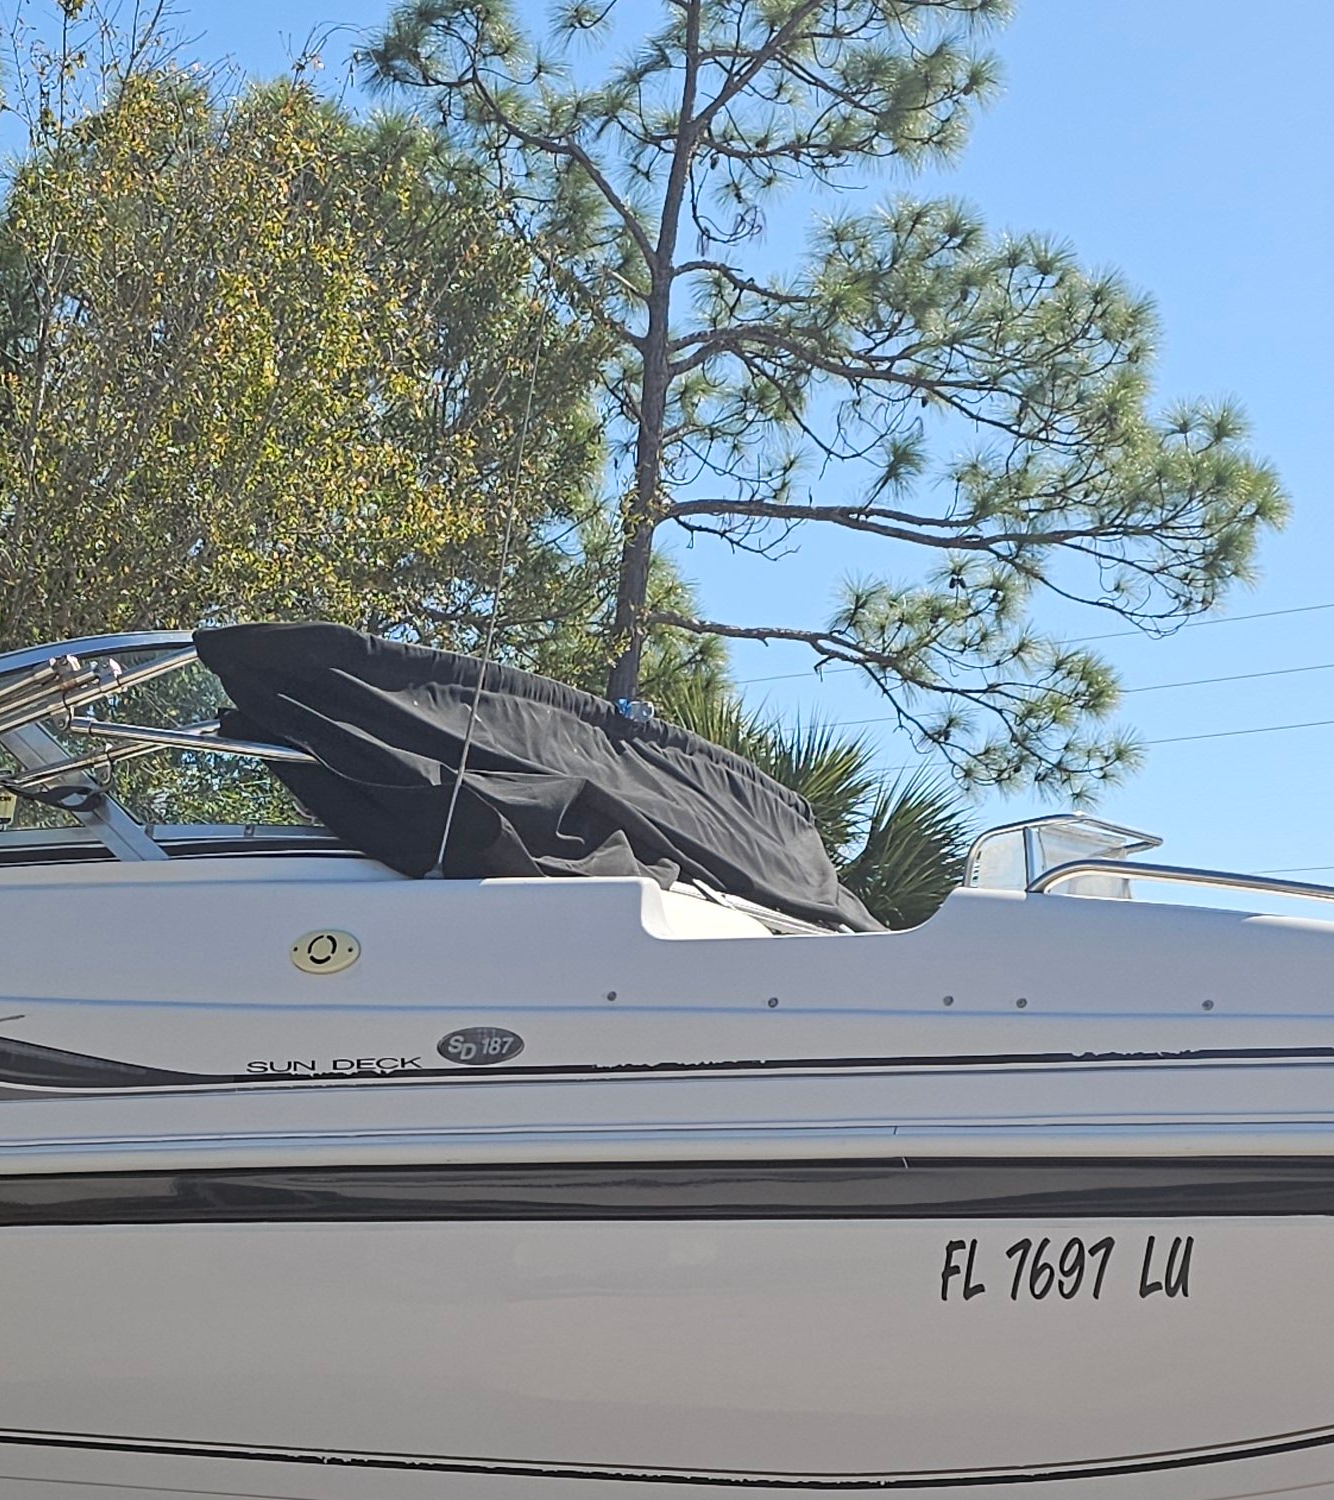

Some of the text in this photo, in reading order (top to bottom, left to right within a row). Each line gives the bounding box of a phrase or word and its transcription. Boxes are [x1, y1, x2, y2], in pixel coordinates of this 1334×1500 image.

[448, 1035, 514, 1060] SD 187
[246, 1057, 422, 1073] SUN DECK
[941, 1238, 986, 1301] FL
[1139, 1235, 1194, 1299] LU
